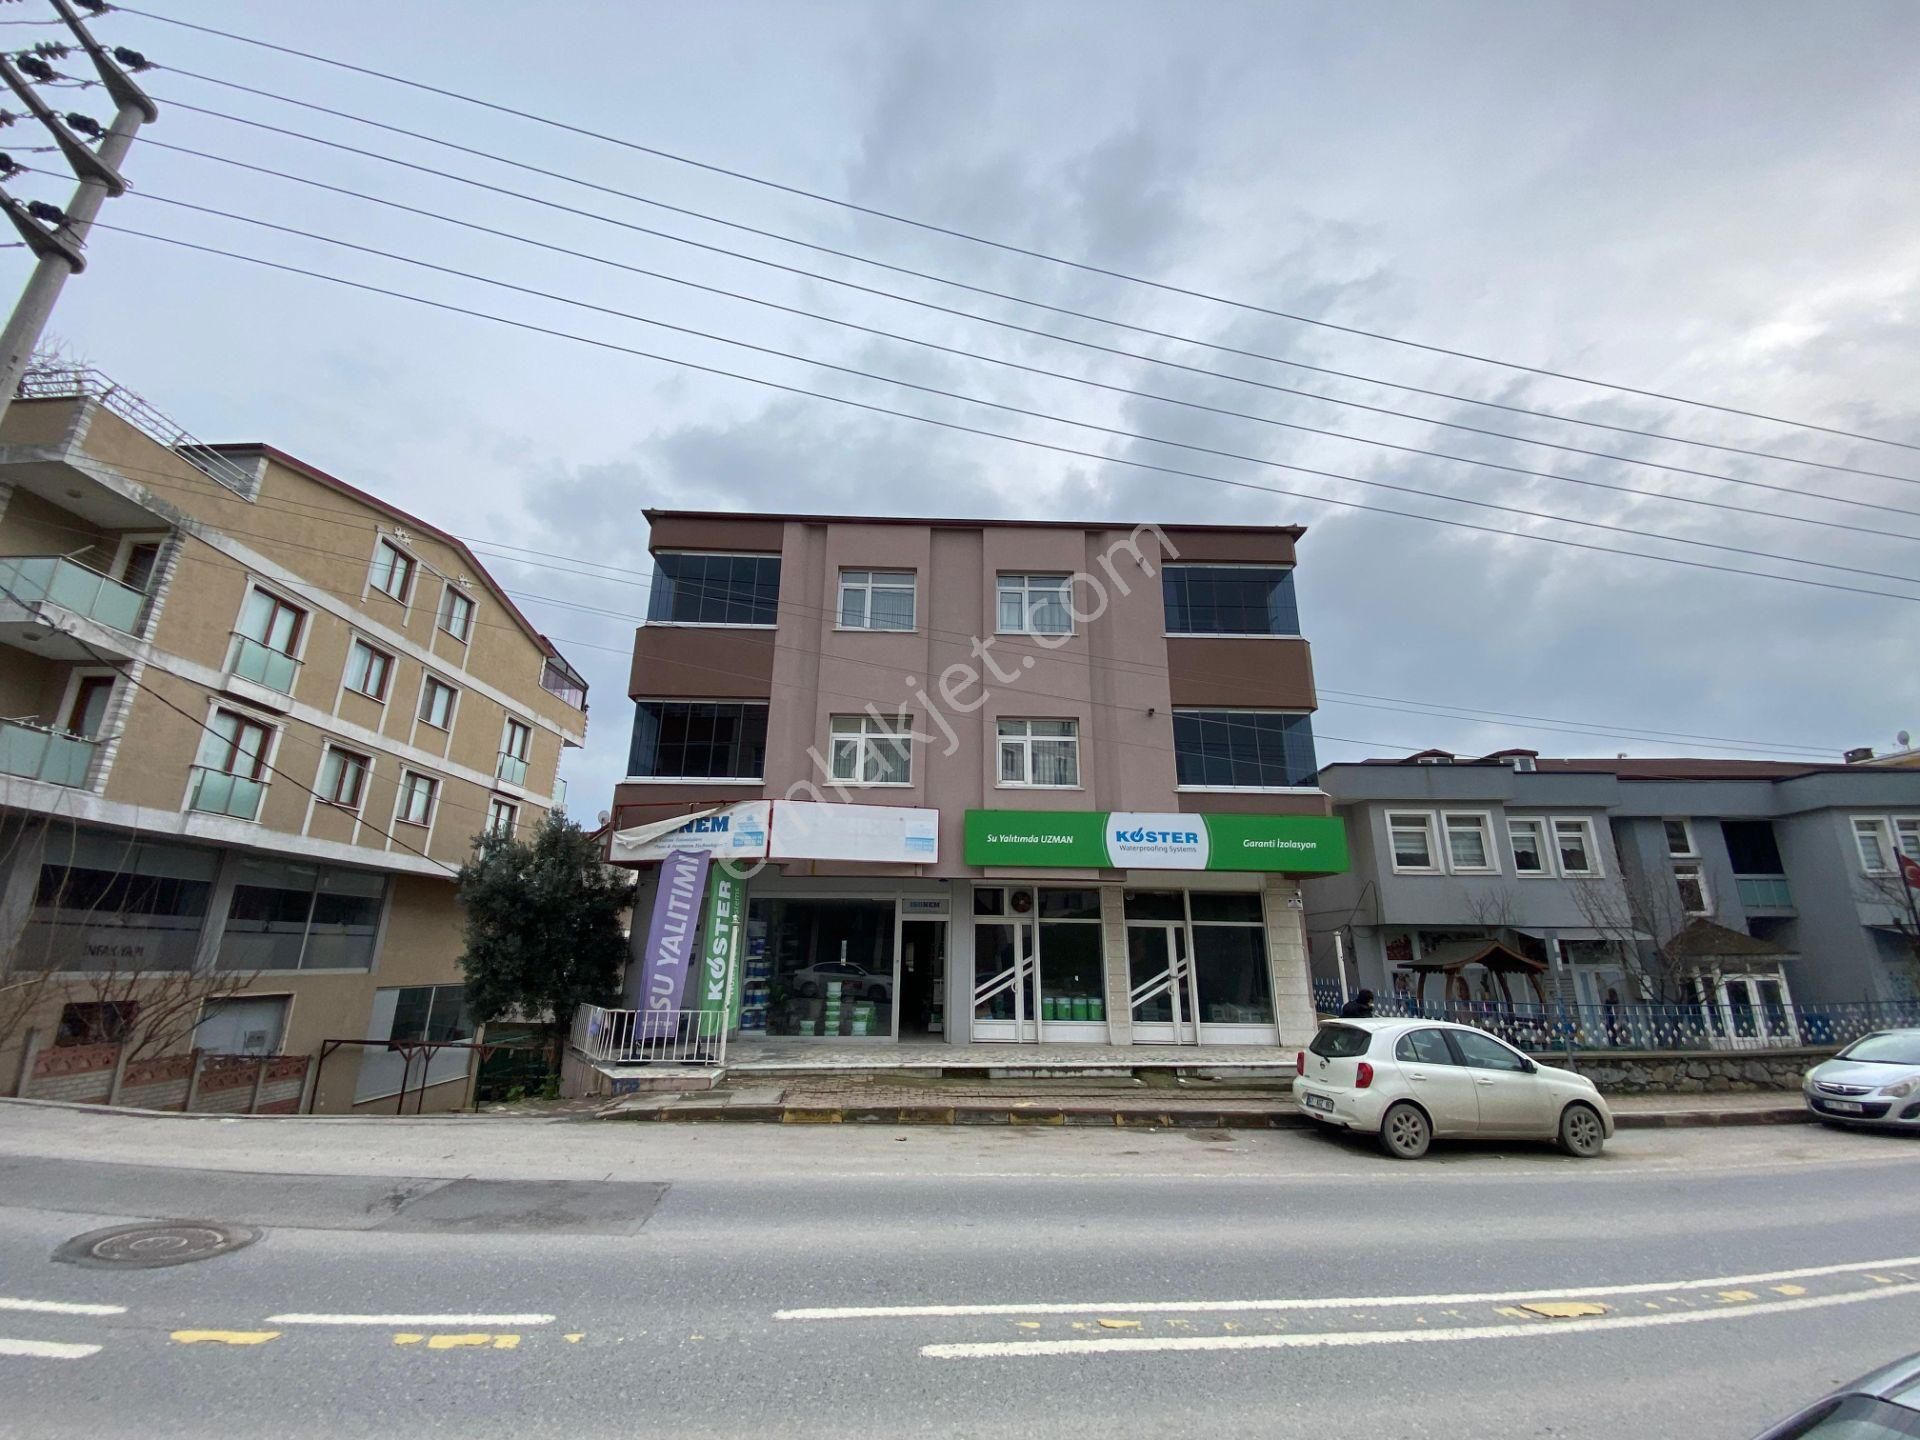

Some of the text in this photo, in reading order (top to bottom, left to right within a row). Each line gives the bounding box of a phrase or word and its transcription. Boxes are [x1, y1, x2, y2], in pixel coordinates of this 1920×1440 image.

[672, 816, 730, 833] NEM
[987, 833, 1074, 844] Su Yalıtımda UZMAN
[1243, 838, 1317, 851] Garanti İzolasyon
[1119, 845, 1197, 854] Waterproofing Systems
[650, 974, 676, 1012] SU
